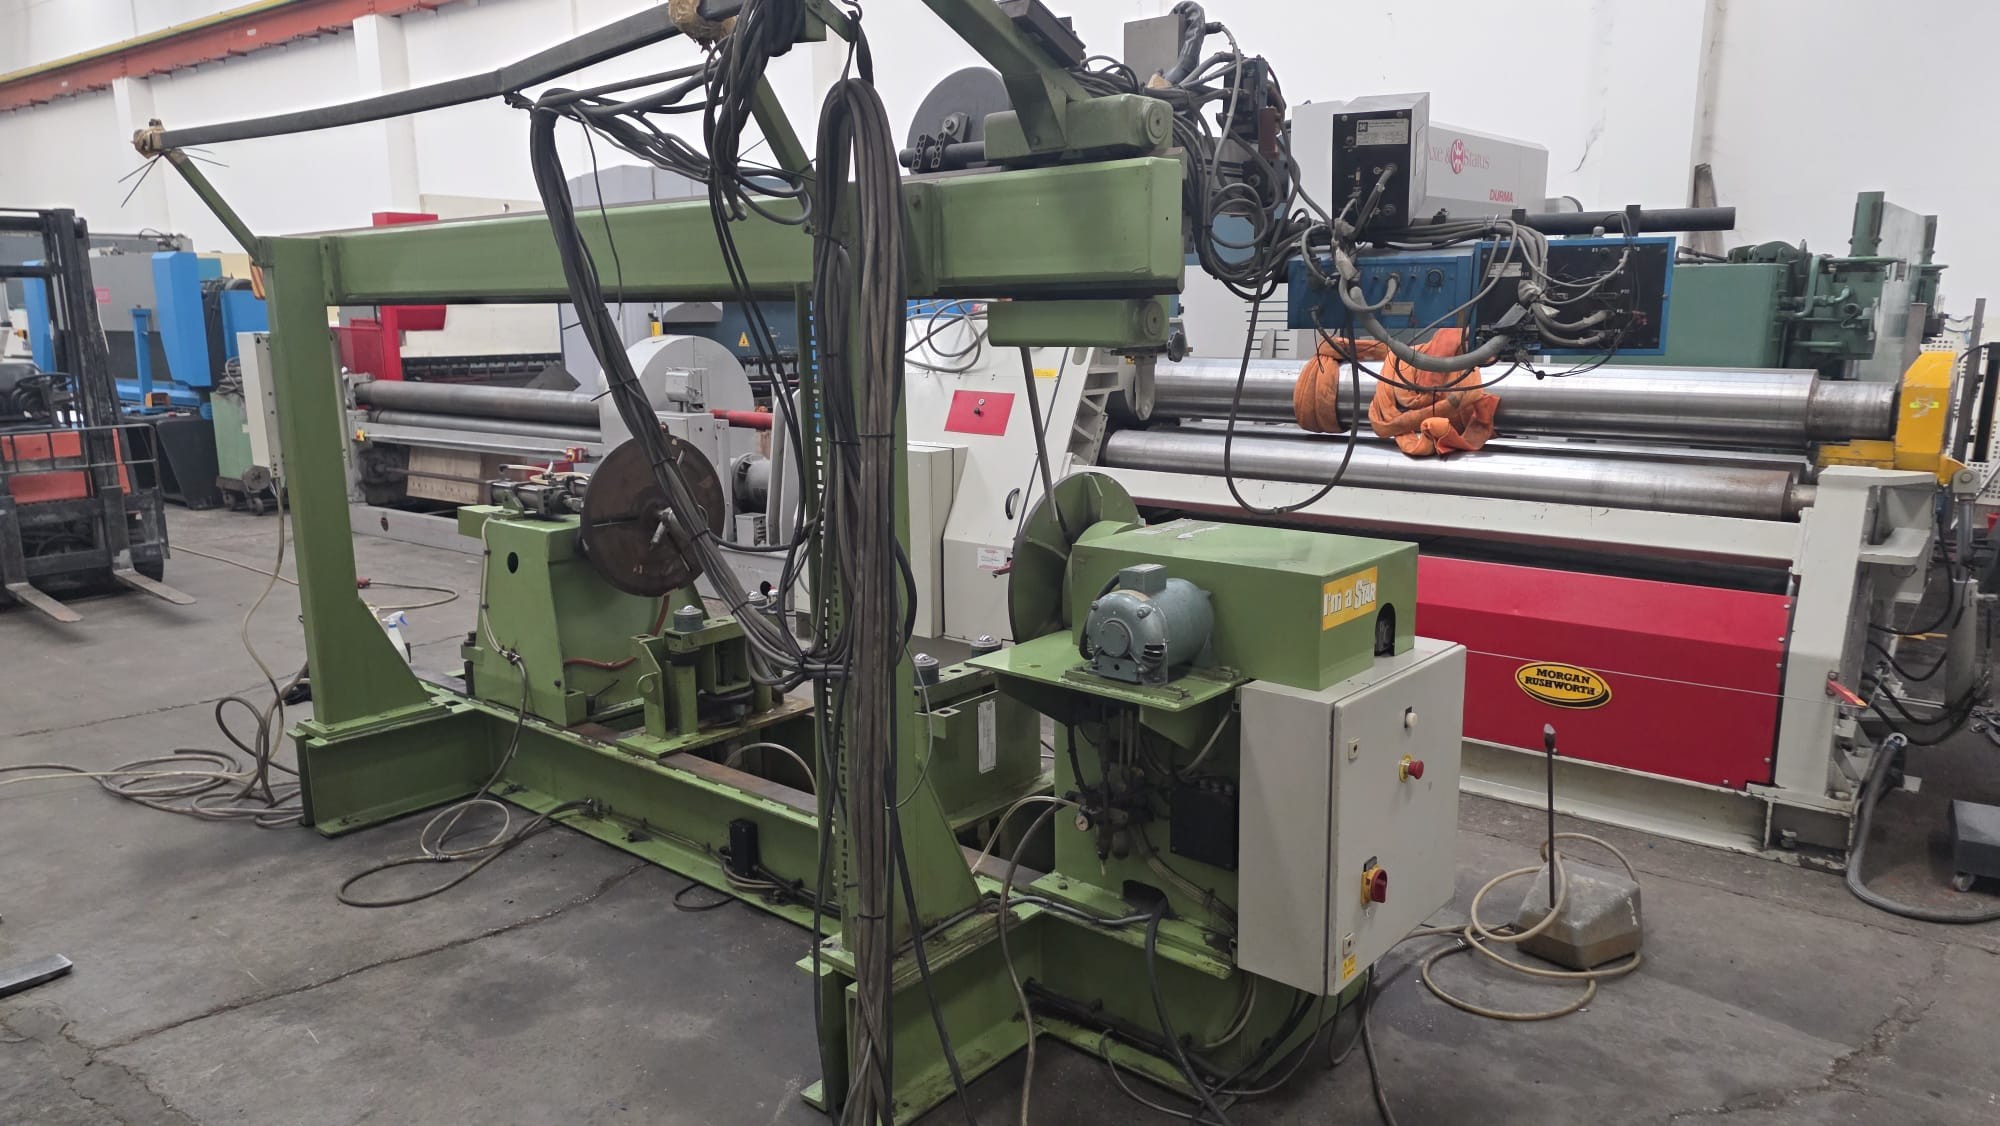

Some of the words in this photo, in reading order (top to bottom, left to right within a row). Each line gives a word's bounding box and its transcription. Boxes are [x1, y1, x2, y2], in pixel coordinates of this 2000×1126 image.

[1464, 149, 1490, 170] Status
[1489, 189, 1514, 203] DURMA
[1323, 592, 1342, 616] I'm
[1345, 589, 1352, 608] a
[1525, 676, 1595, 696] RUSHWORTH
[1536, 668, 1590, 684] MORGAN
